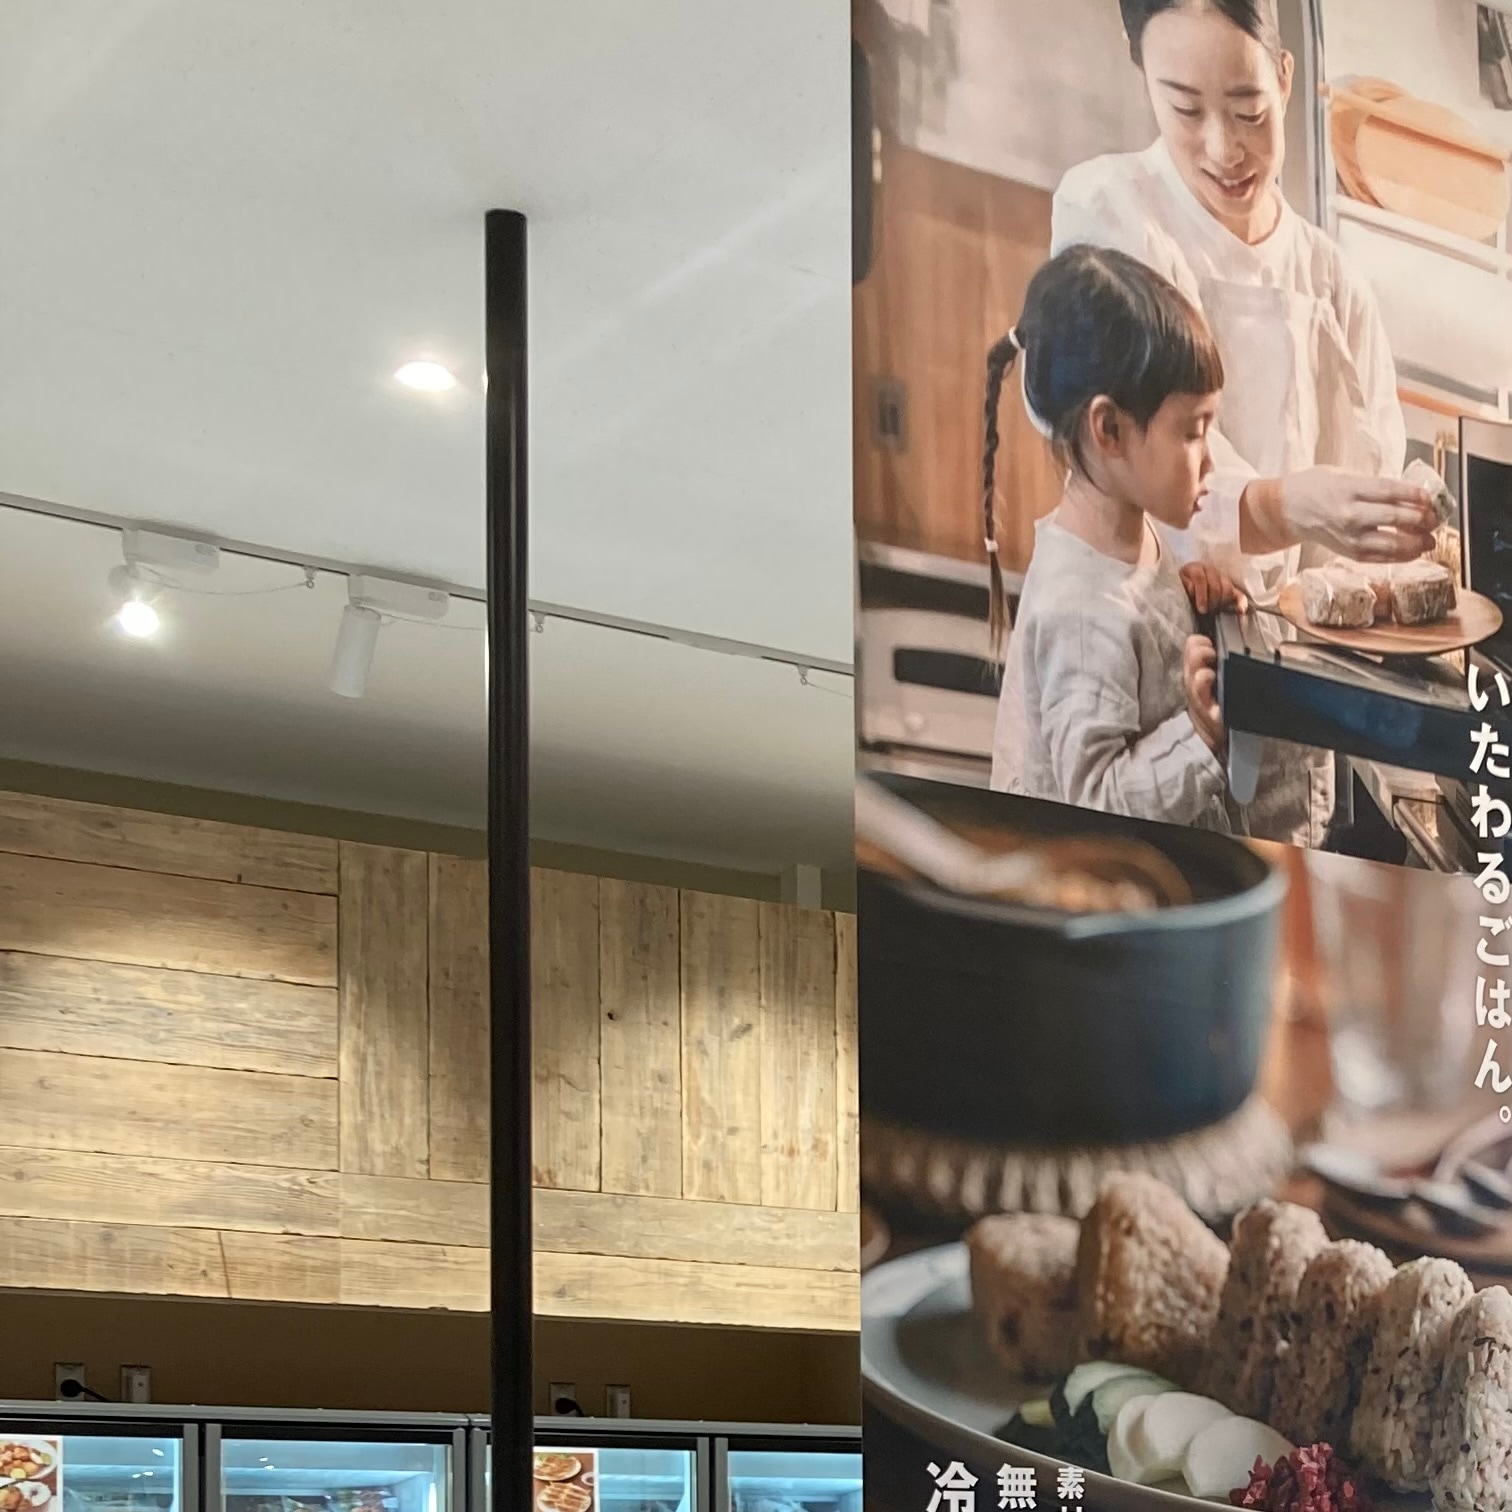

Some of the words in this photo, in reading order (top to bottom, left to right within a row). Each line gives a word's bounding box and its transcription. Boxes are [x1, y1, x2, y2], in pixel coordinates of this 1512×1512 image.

[1467, 663, 1512, 1124] いたわるごはん。
